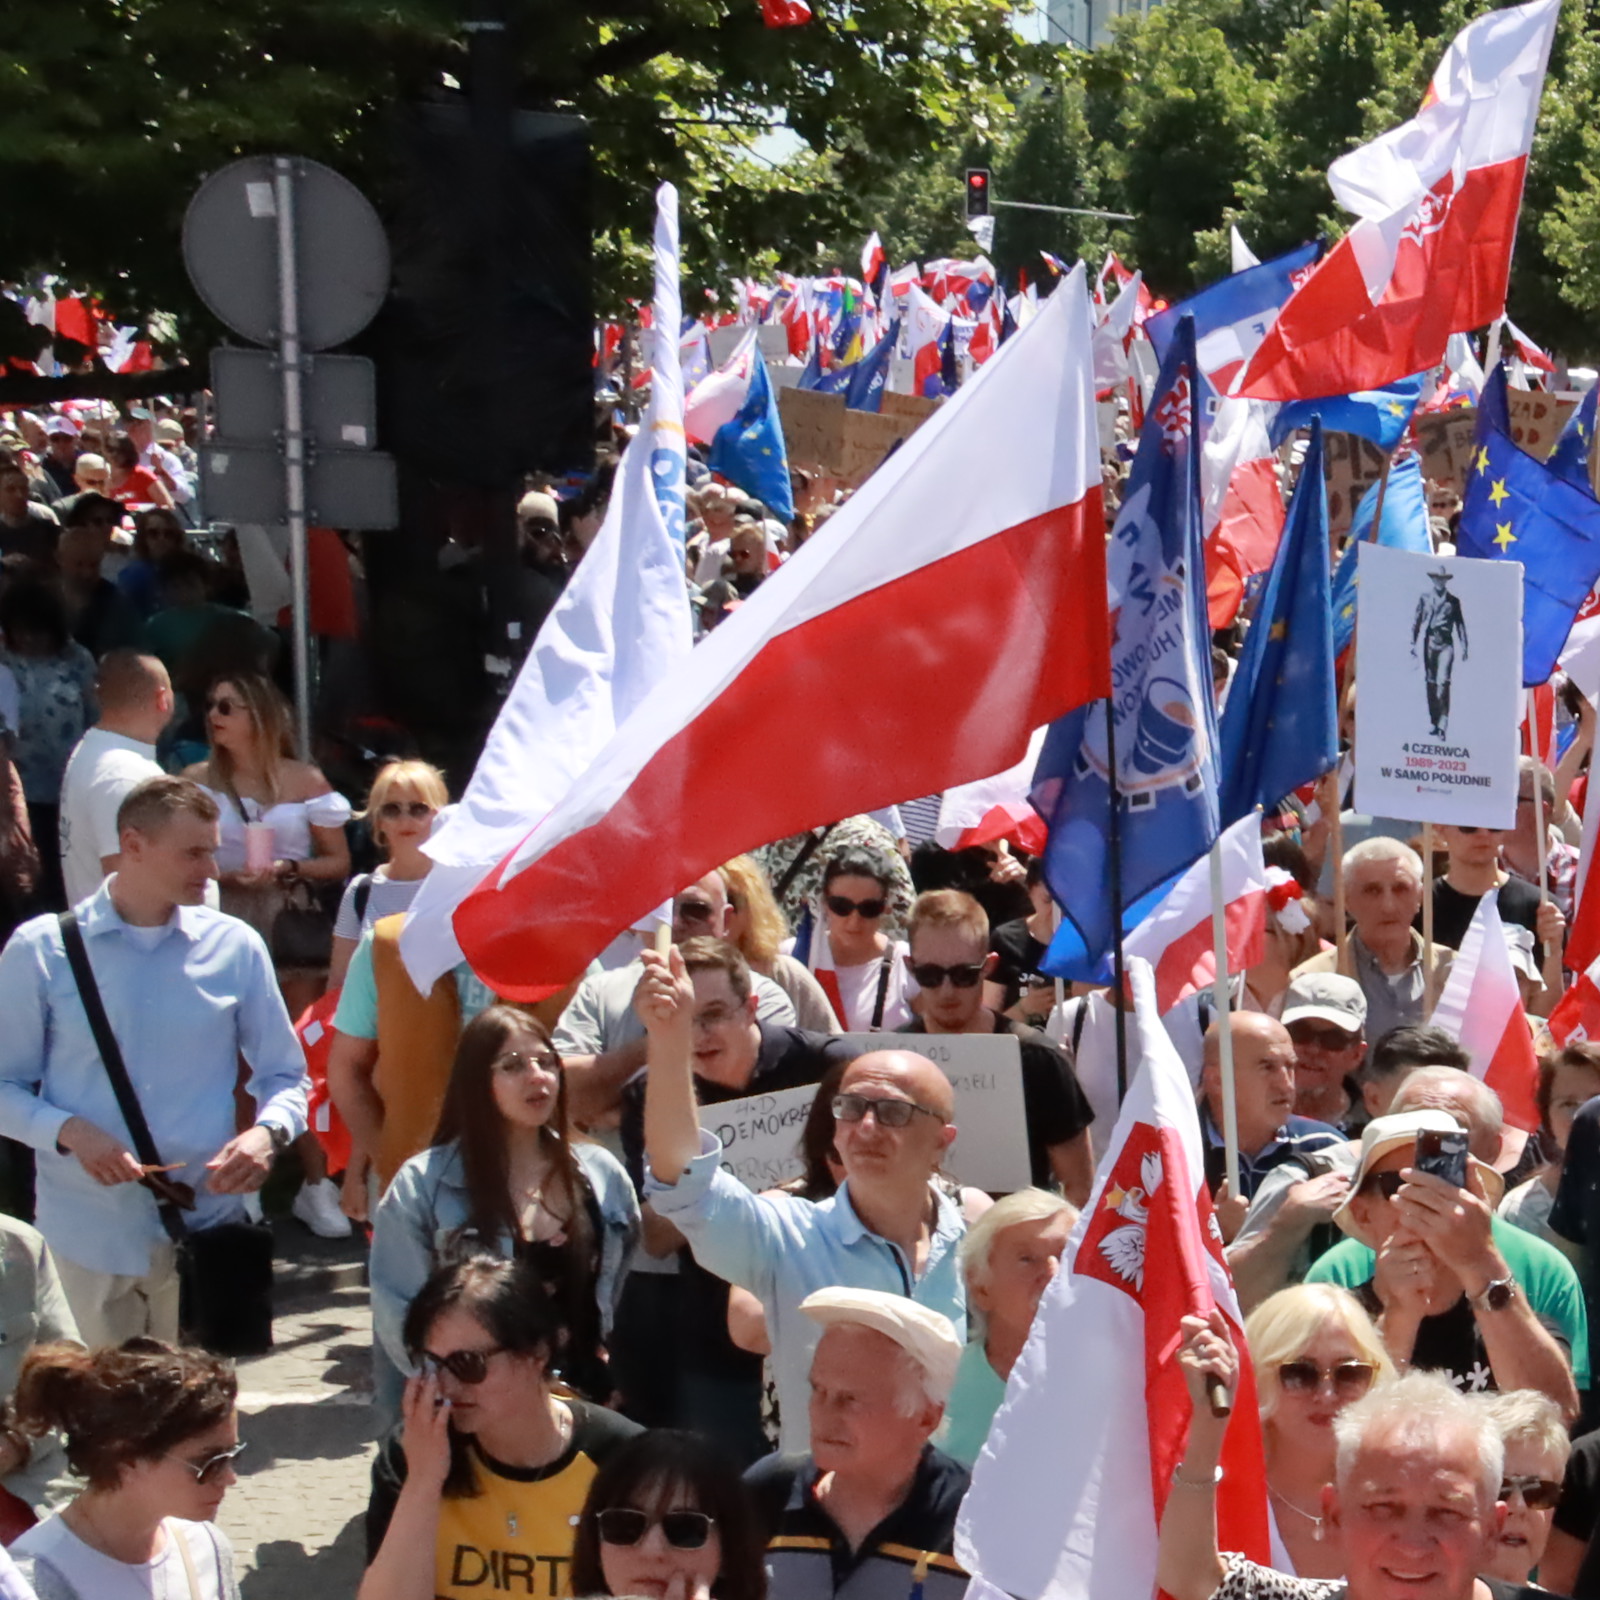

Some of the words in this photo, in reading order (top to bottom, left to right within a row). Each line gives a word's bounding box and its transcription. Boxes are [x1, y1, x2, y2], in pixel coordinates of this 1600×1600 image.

[1402, 743, 1410, 752] 4
[1411, 743, 1471, 758] CZERWCA
[1404, 756, 1467, 772] 1989-2023
[1380, 767, 1392, 778] W
[1395, 768, 1430, 782] SAMO
[1431, 772, 1492, 787] POŁUDNIE
